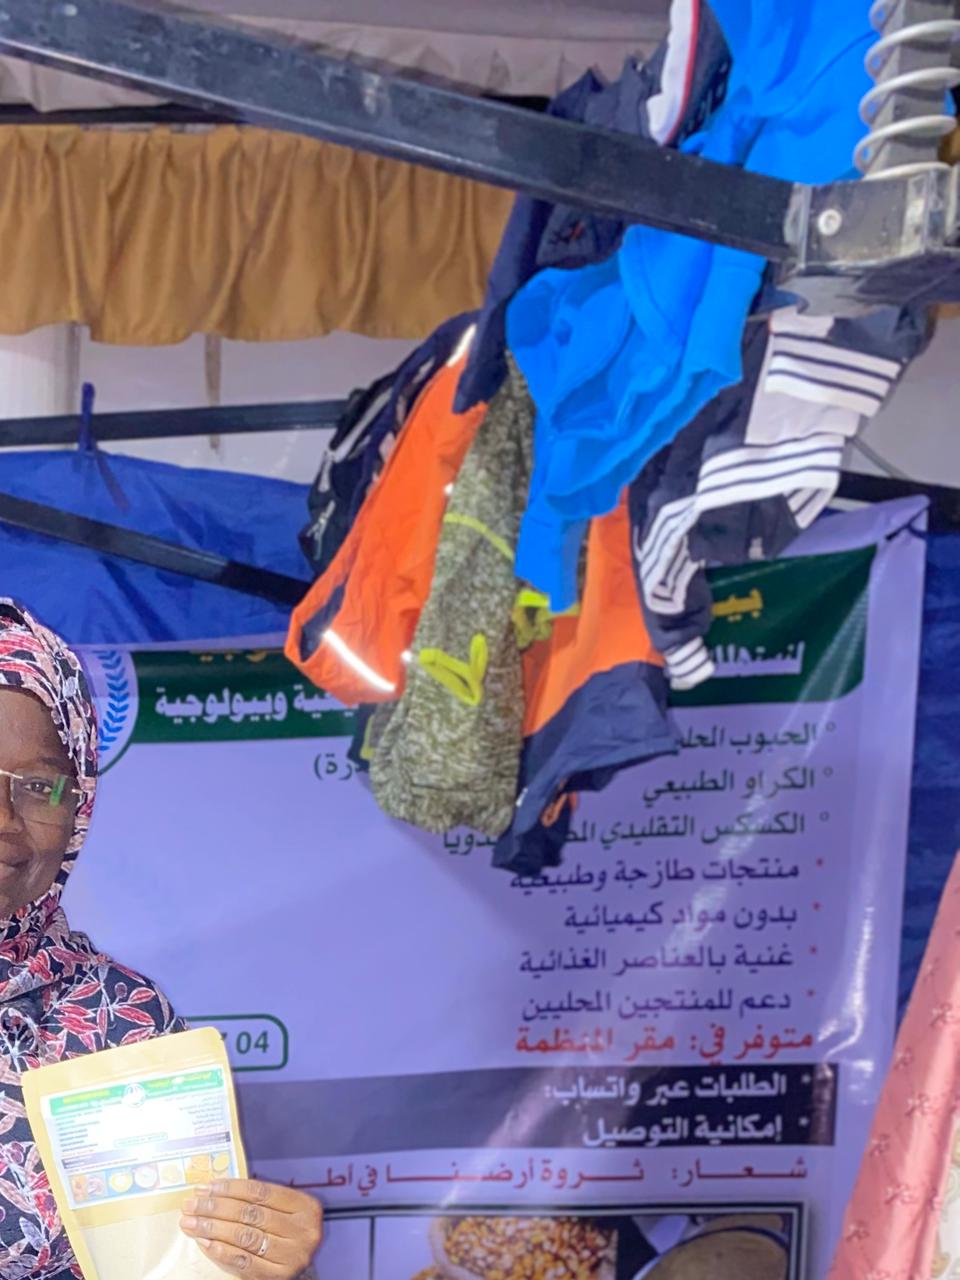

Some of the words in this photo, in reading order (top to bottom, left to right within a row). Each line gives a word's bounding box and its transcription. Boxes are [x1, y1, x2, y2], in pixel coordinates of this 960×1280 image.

[155, 686, 288, 723] وبيولوجية
[729, 722, 816, 756] الحبوب
[642, 769, 734, 808] الطبيعي
[600, 816, 696, 850] التقليدي
[700, 810, 806, 845] الكسكس
[613, 859, 696, 889] طازجة
[701, 857, 800, 885] منتجات
[564, 901, 664, 935] كيميائية
[671, 906, 727, 928] مواد
[734, 907, 797, 930] بدون
[519, 947, 606, 979] الغذائية
[613, 945, 727, 976] بالعناصر
[734, 943, 794, 974] غنية
[522, 991, 611, 1021] المحليين
[617, 988, 733, 1019] للمنتجين
[739, 992, 792, 1018] دعم
[235, 1030, 270, 1055] 04
[516, 1026, 613, 1054] المنظمة
[624, 1027, 676, 1061] مقر
[734, 1024, 814, 1061] متوفر
[646, 1079, 690, 1106] عبر
[695, 1072, 787, 1103] الطلبات
[582, 1116, 689, 1147] التوصيل
[694, 1113, 783, 1144] إمكانية
[356, 1163, 378, 1197] في
